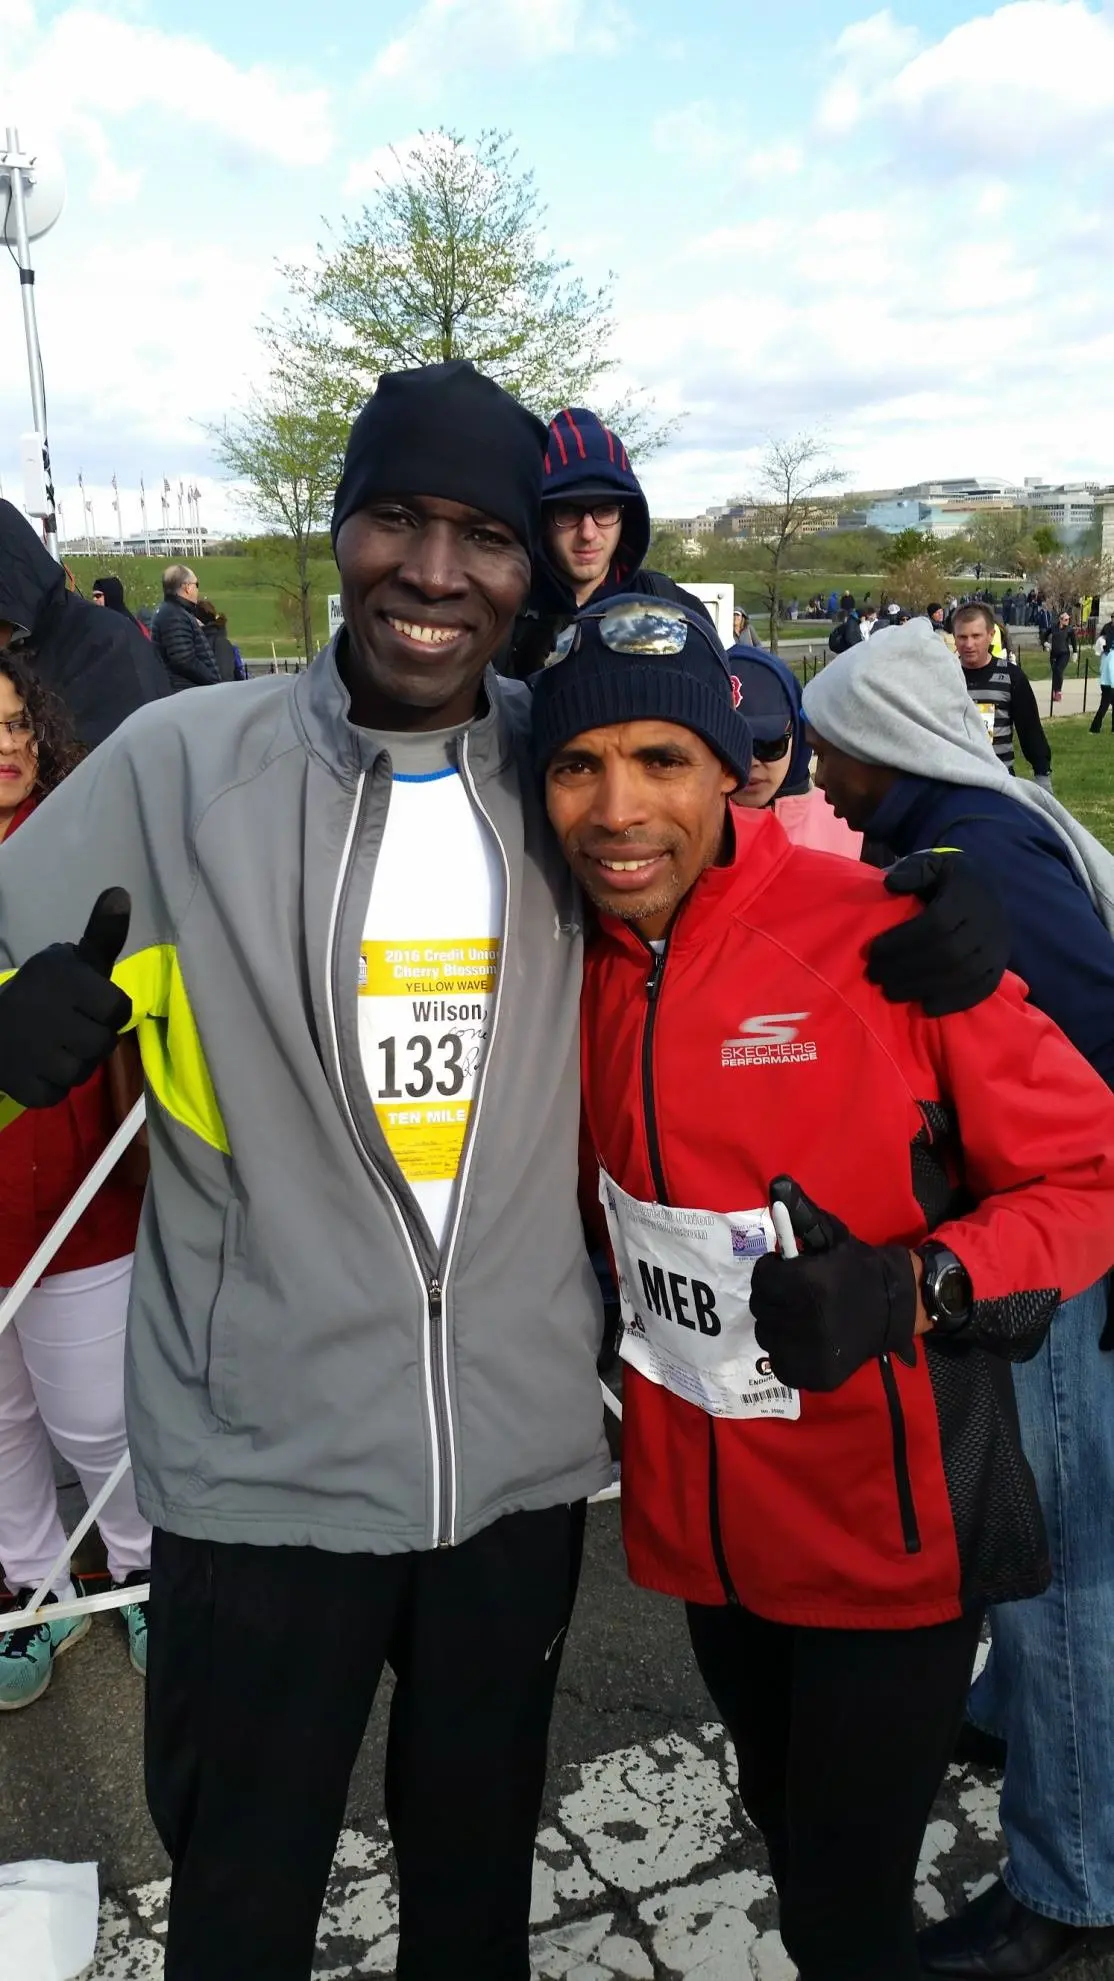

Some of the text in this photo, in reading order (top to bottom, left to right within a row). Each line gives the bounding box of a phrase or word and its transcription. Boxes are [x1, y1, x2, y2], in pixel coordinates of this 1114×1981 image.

[385, 947, 498, 963] 2016 Credit Unio
[393, 962, 497, 979] Cherry Blossom
[406, 980, 488, 993] YELLOW WAVE
[721, 1041, 817, 1059] SKECHERS
[378, 1034, 464, 1098] 133
[721, 1052, 818, 1067] PERFORMANCE
[387, 1109, 467, 1125] TEN MILE
[638, 1259, 722, 1337] MEB
